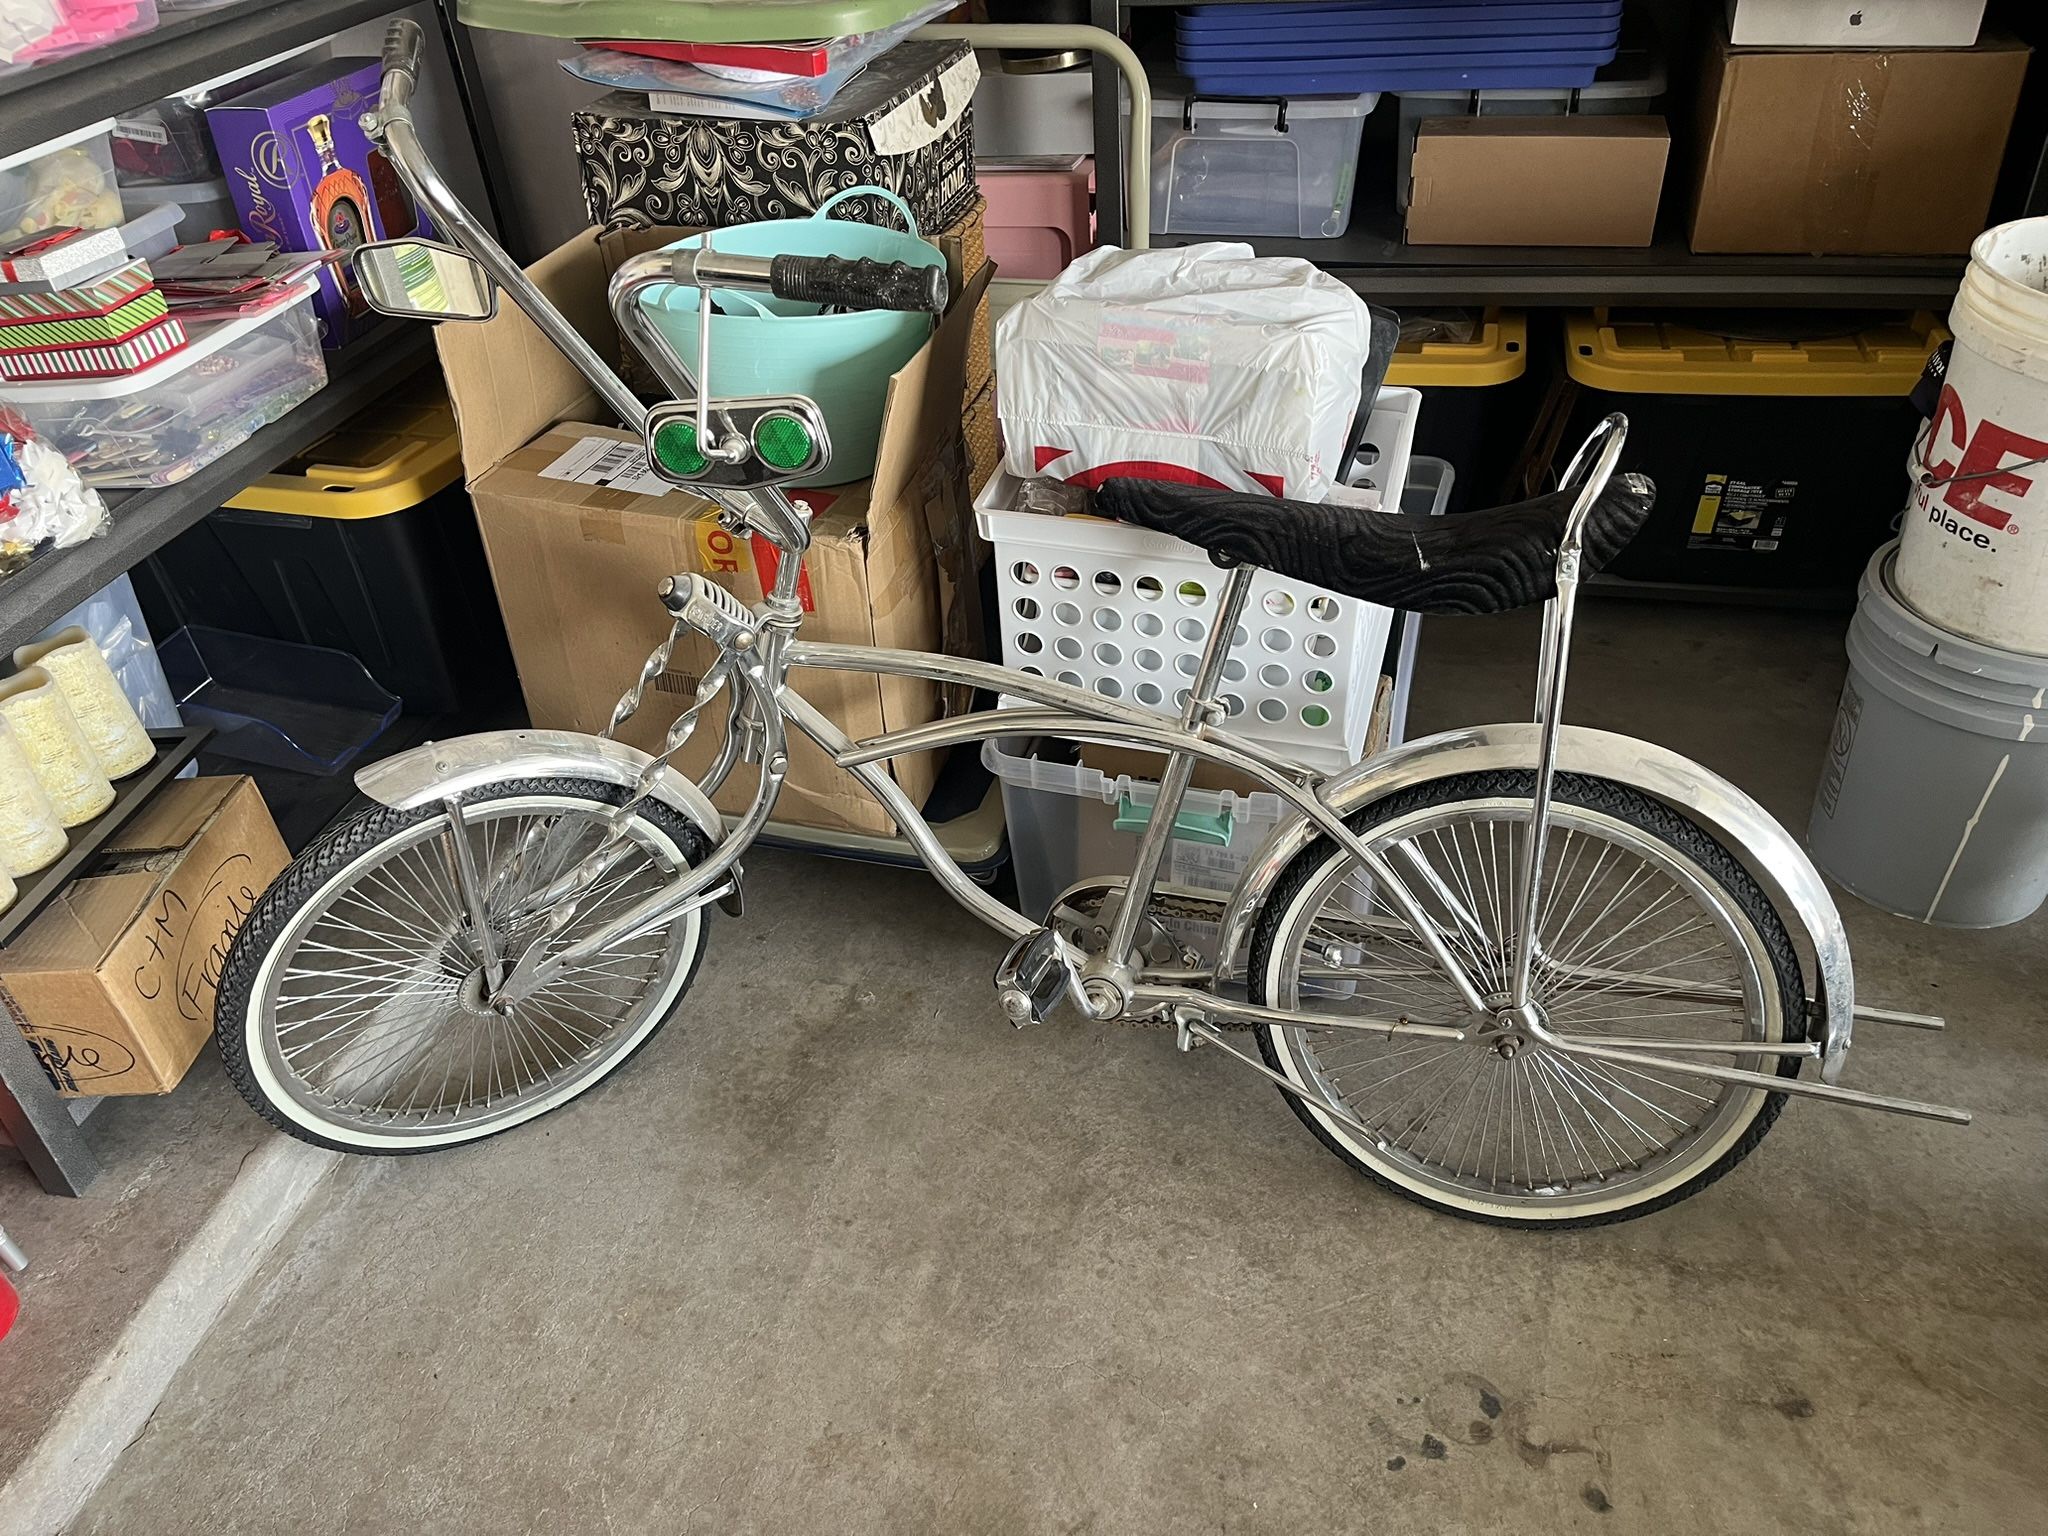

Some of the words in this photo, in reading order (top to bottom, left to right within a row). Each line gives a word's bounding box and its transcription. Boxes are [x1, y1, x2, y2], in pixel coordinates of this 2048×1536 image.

[234, 166, 283, 250] Royal
[1928, 505, 1997, 553] place.
[1184, 921, 1218, 937] China
